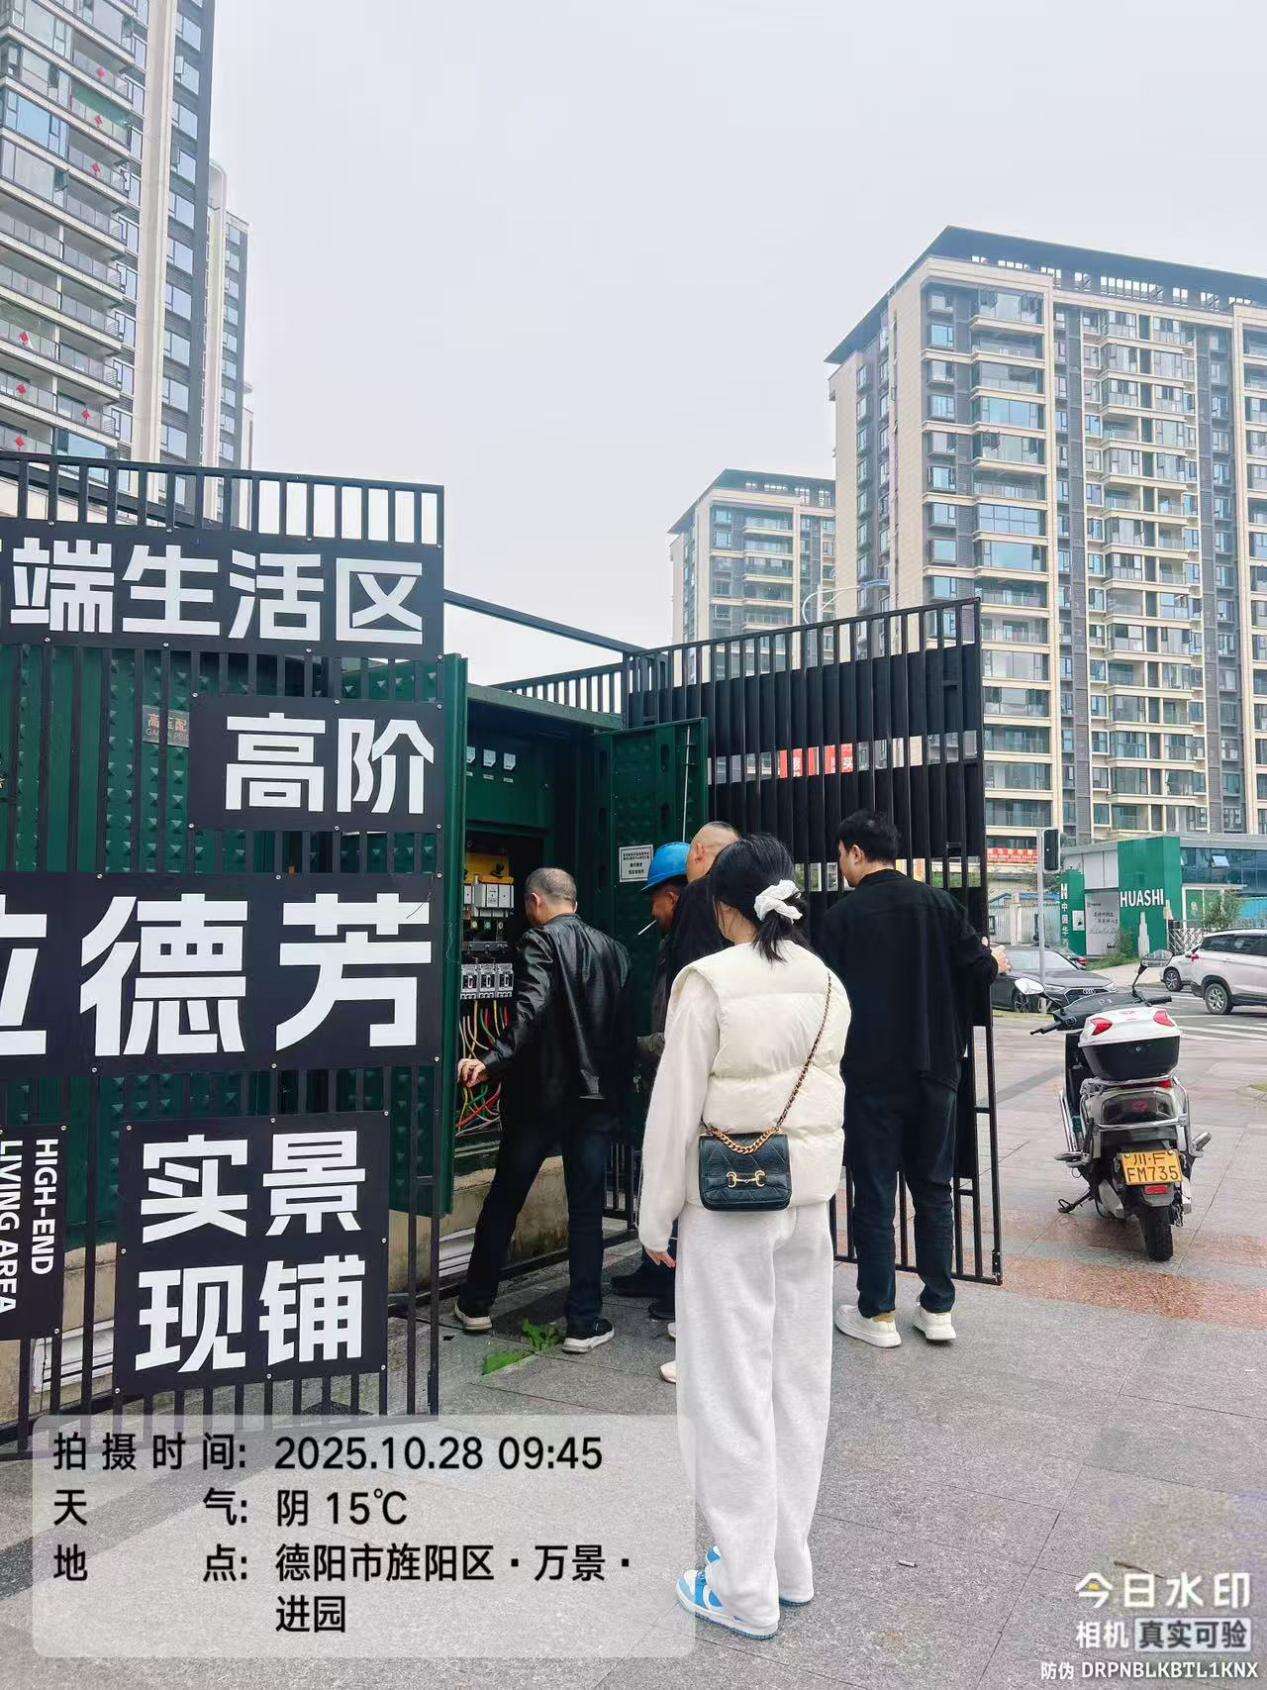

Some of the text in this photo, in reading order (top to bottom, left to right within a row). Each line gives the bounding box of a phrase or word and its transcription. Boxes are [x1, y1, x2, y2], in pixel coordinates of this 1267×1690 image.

[0, 537, 423, 645] 端生活区
[225, 712, 434, 814] 高阶
[1119, 888, 1164, 908] HUASHI
[0, 1140, 23, 1314] LIVING AREA
[31, 1139, 59, 1275] HIGH-END
[140, 1131, 366, 1244] 实景
[1127, 1165, 1179, 1182] FM735
[135, 1254, 366, 1373] 现铺
